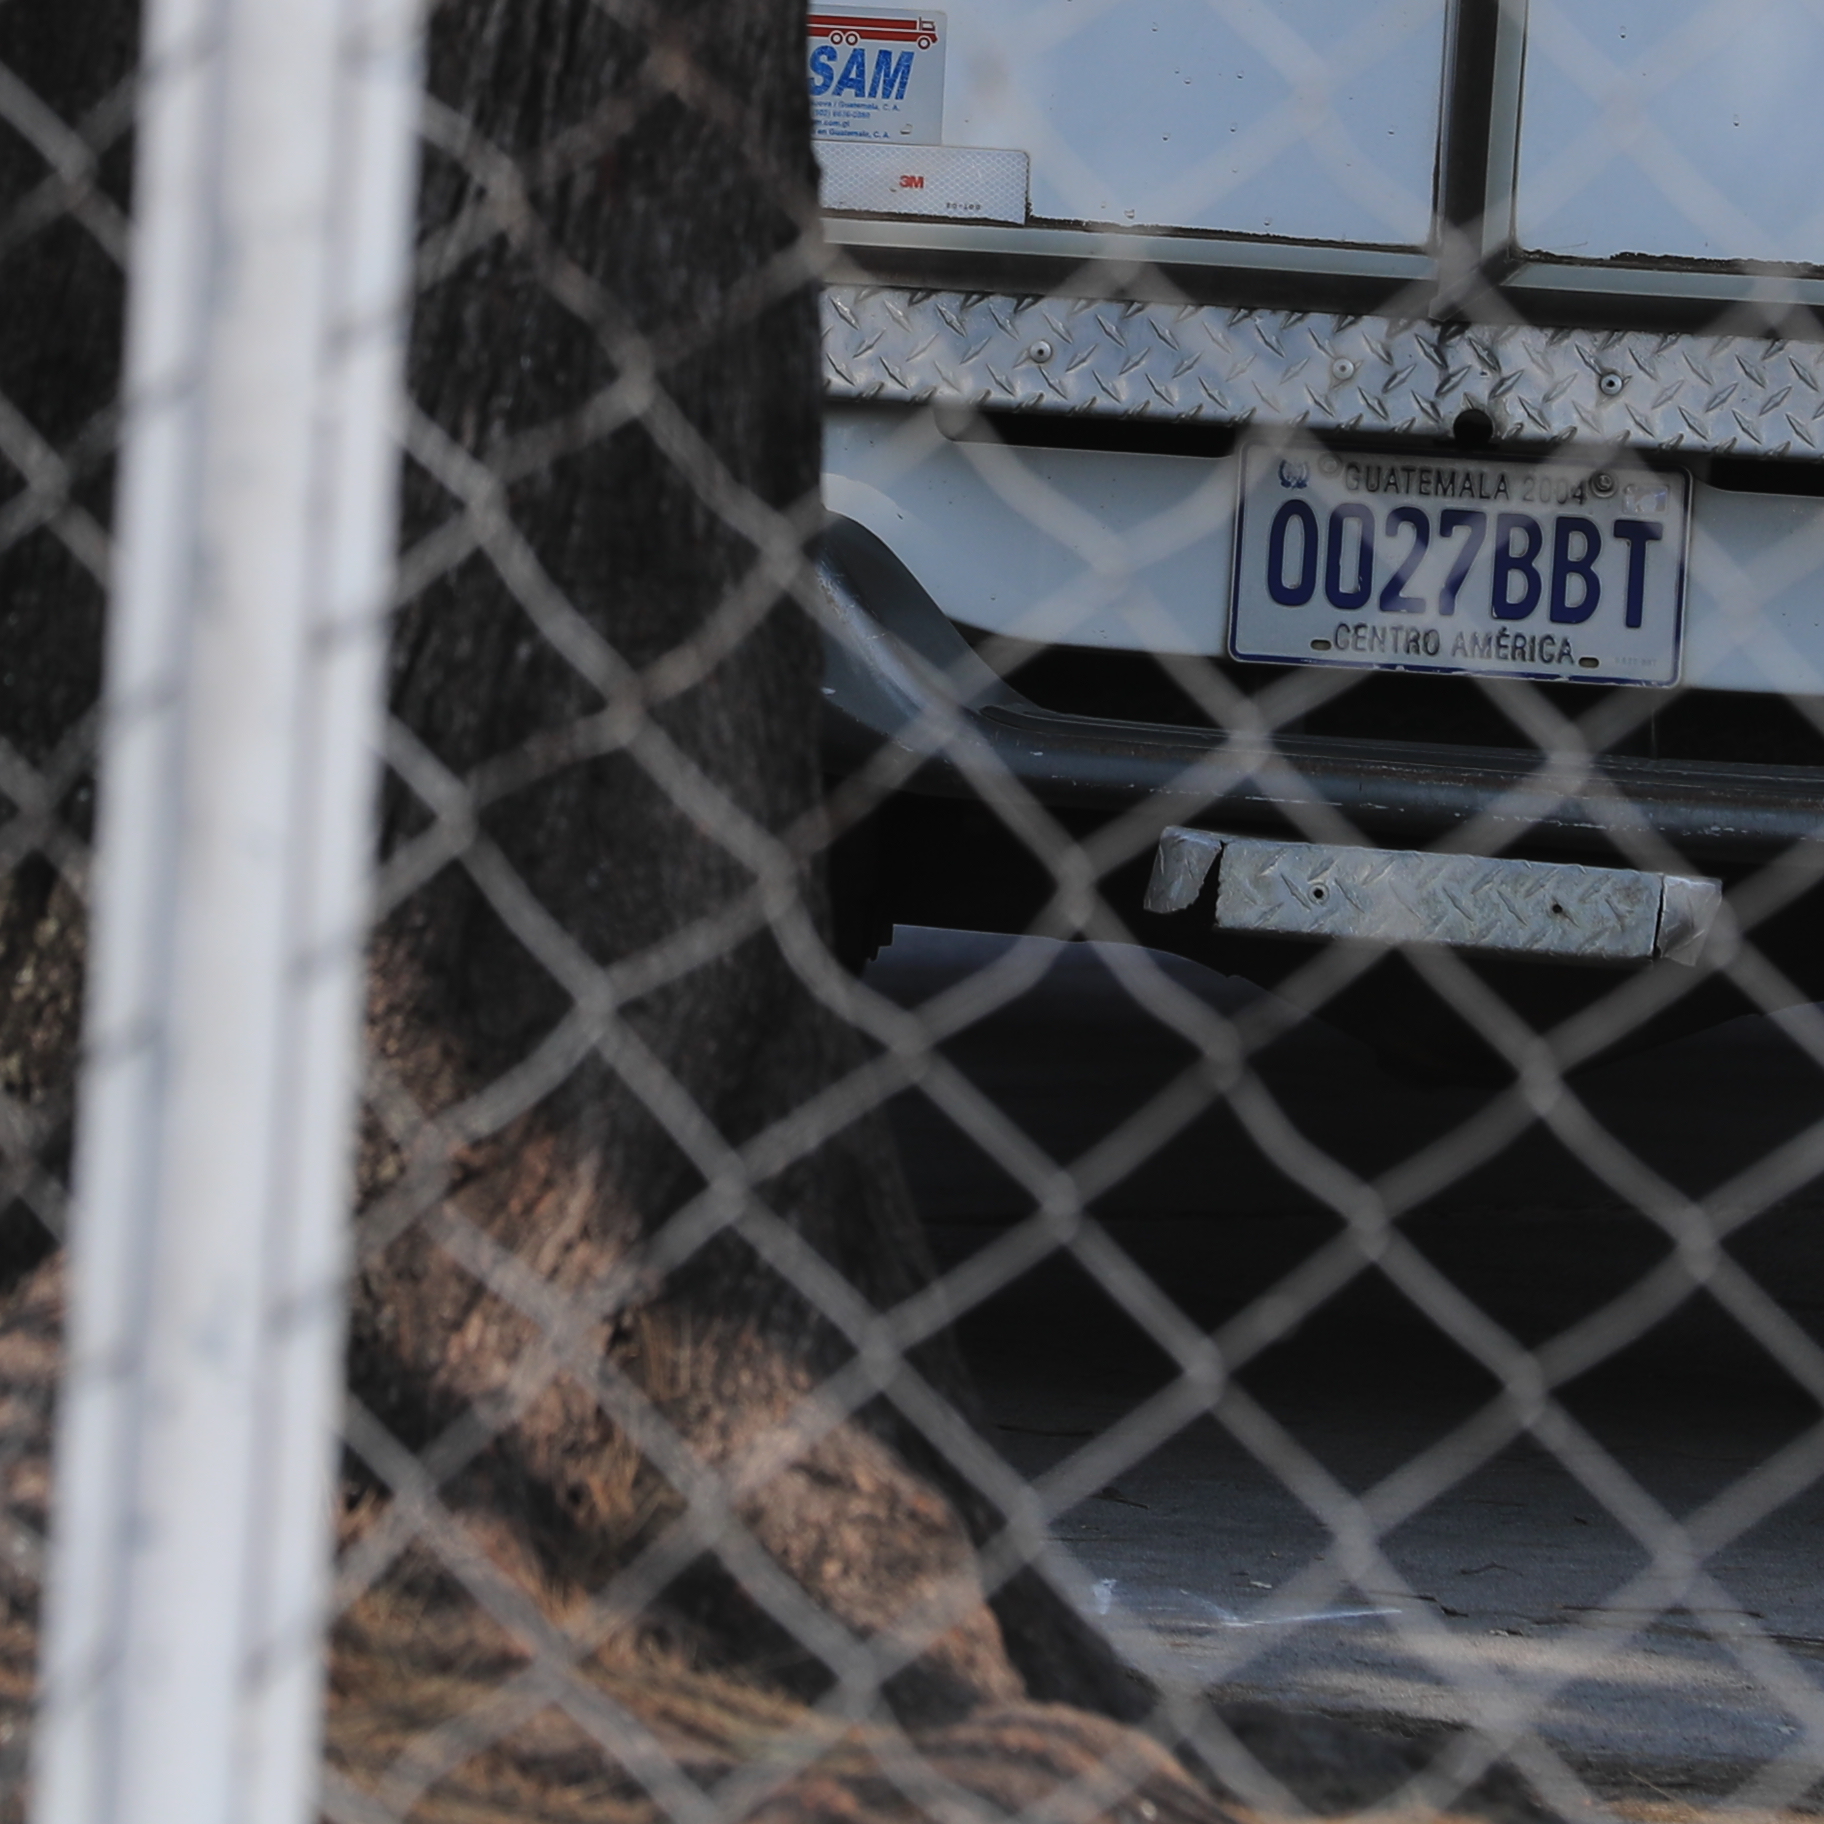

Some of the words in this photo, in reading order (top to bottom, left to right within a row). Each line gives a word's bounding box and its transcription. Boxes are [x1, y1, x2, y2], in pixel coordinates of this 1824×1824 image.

[899, 175, 925, 189] 3M
[1344, 461, 1510, 500] GUATEMALA
[1522, 476, 1587, 505] 2004
[1266, 499, 1663, 629] 0027BBT
[1332, 622, 1441, 657] CENTRO
[1451, 626, 1575, 665] AMÉRICA
